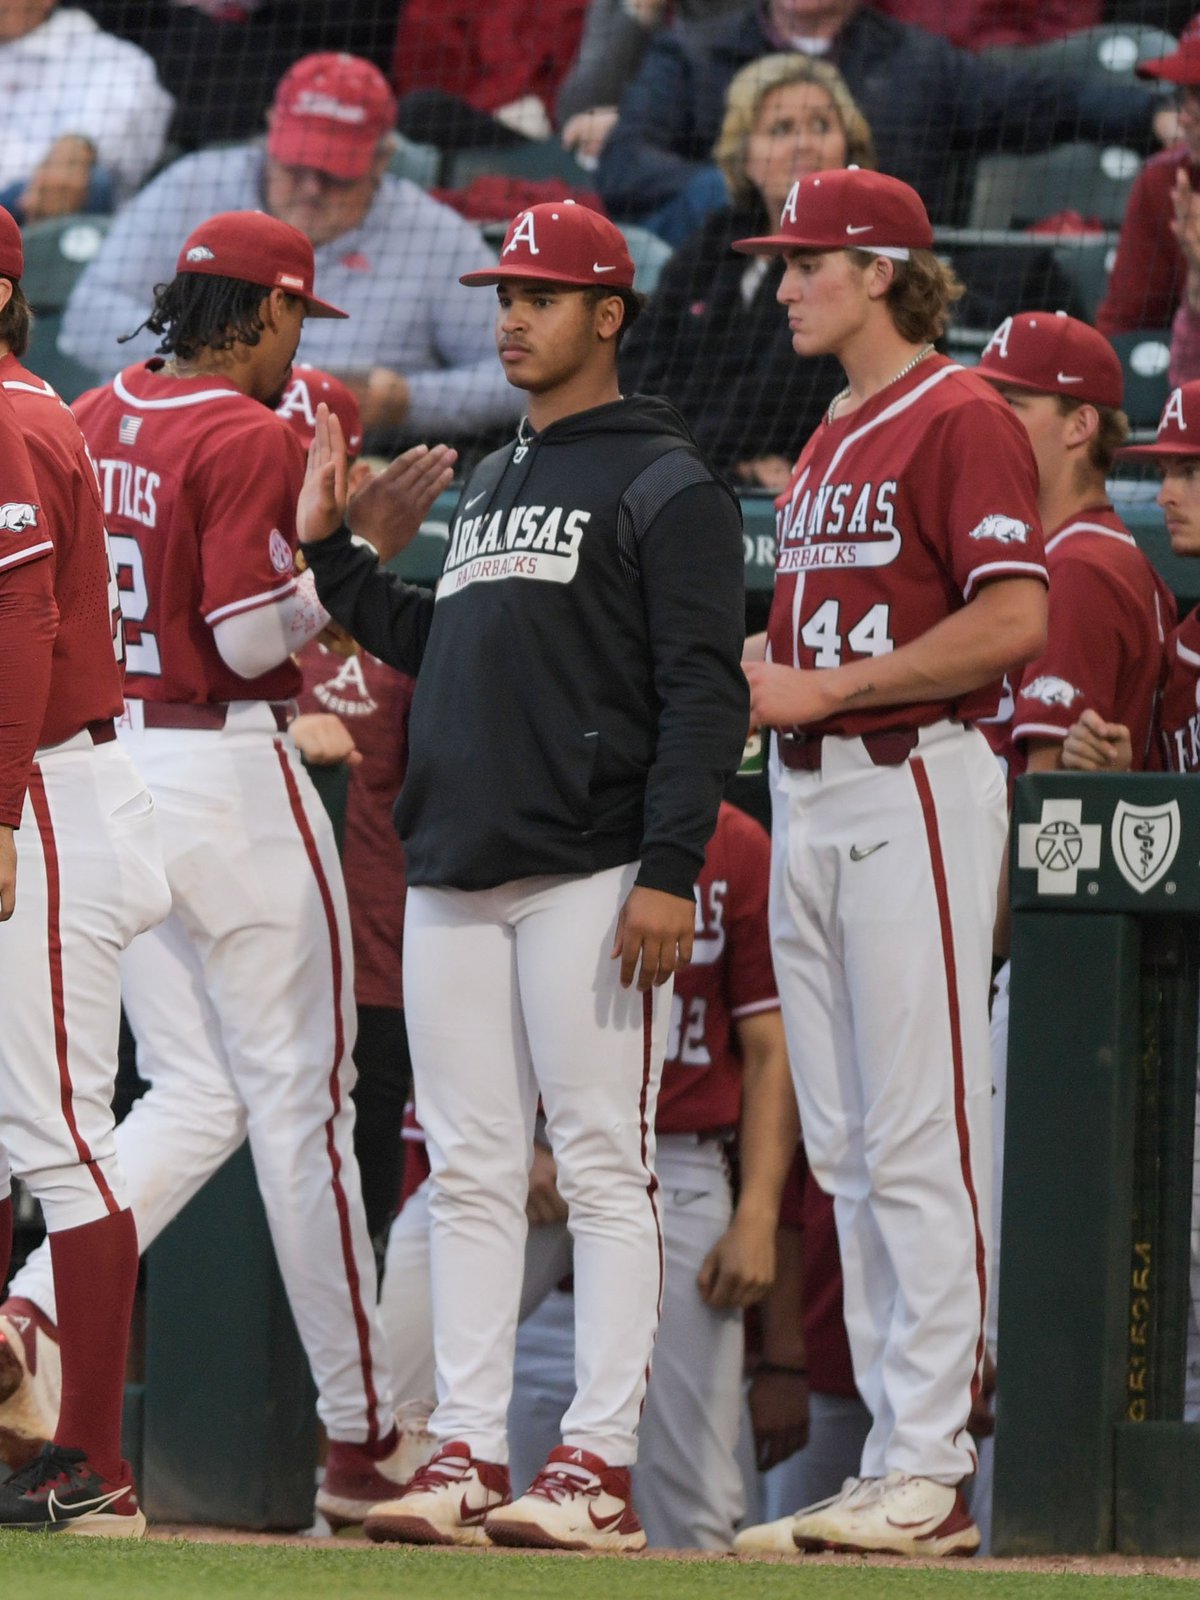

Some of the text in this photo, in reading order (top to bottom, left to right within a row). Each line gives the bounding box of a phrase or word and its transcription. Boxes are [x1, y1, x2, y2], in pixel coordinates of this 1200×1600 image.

[503, 211, 540, 256] A
[981, 316, 1013, 358] A
[275, 379, 316, 427] A
[1156, 387, 1187, 436] A
[443, 505, 591, 573] ARKANSAS
[801, 599, 895, 669] 44
